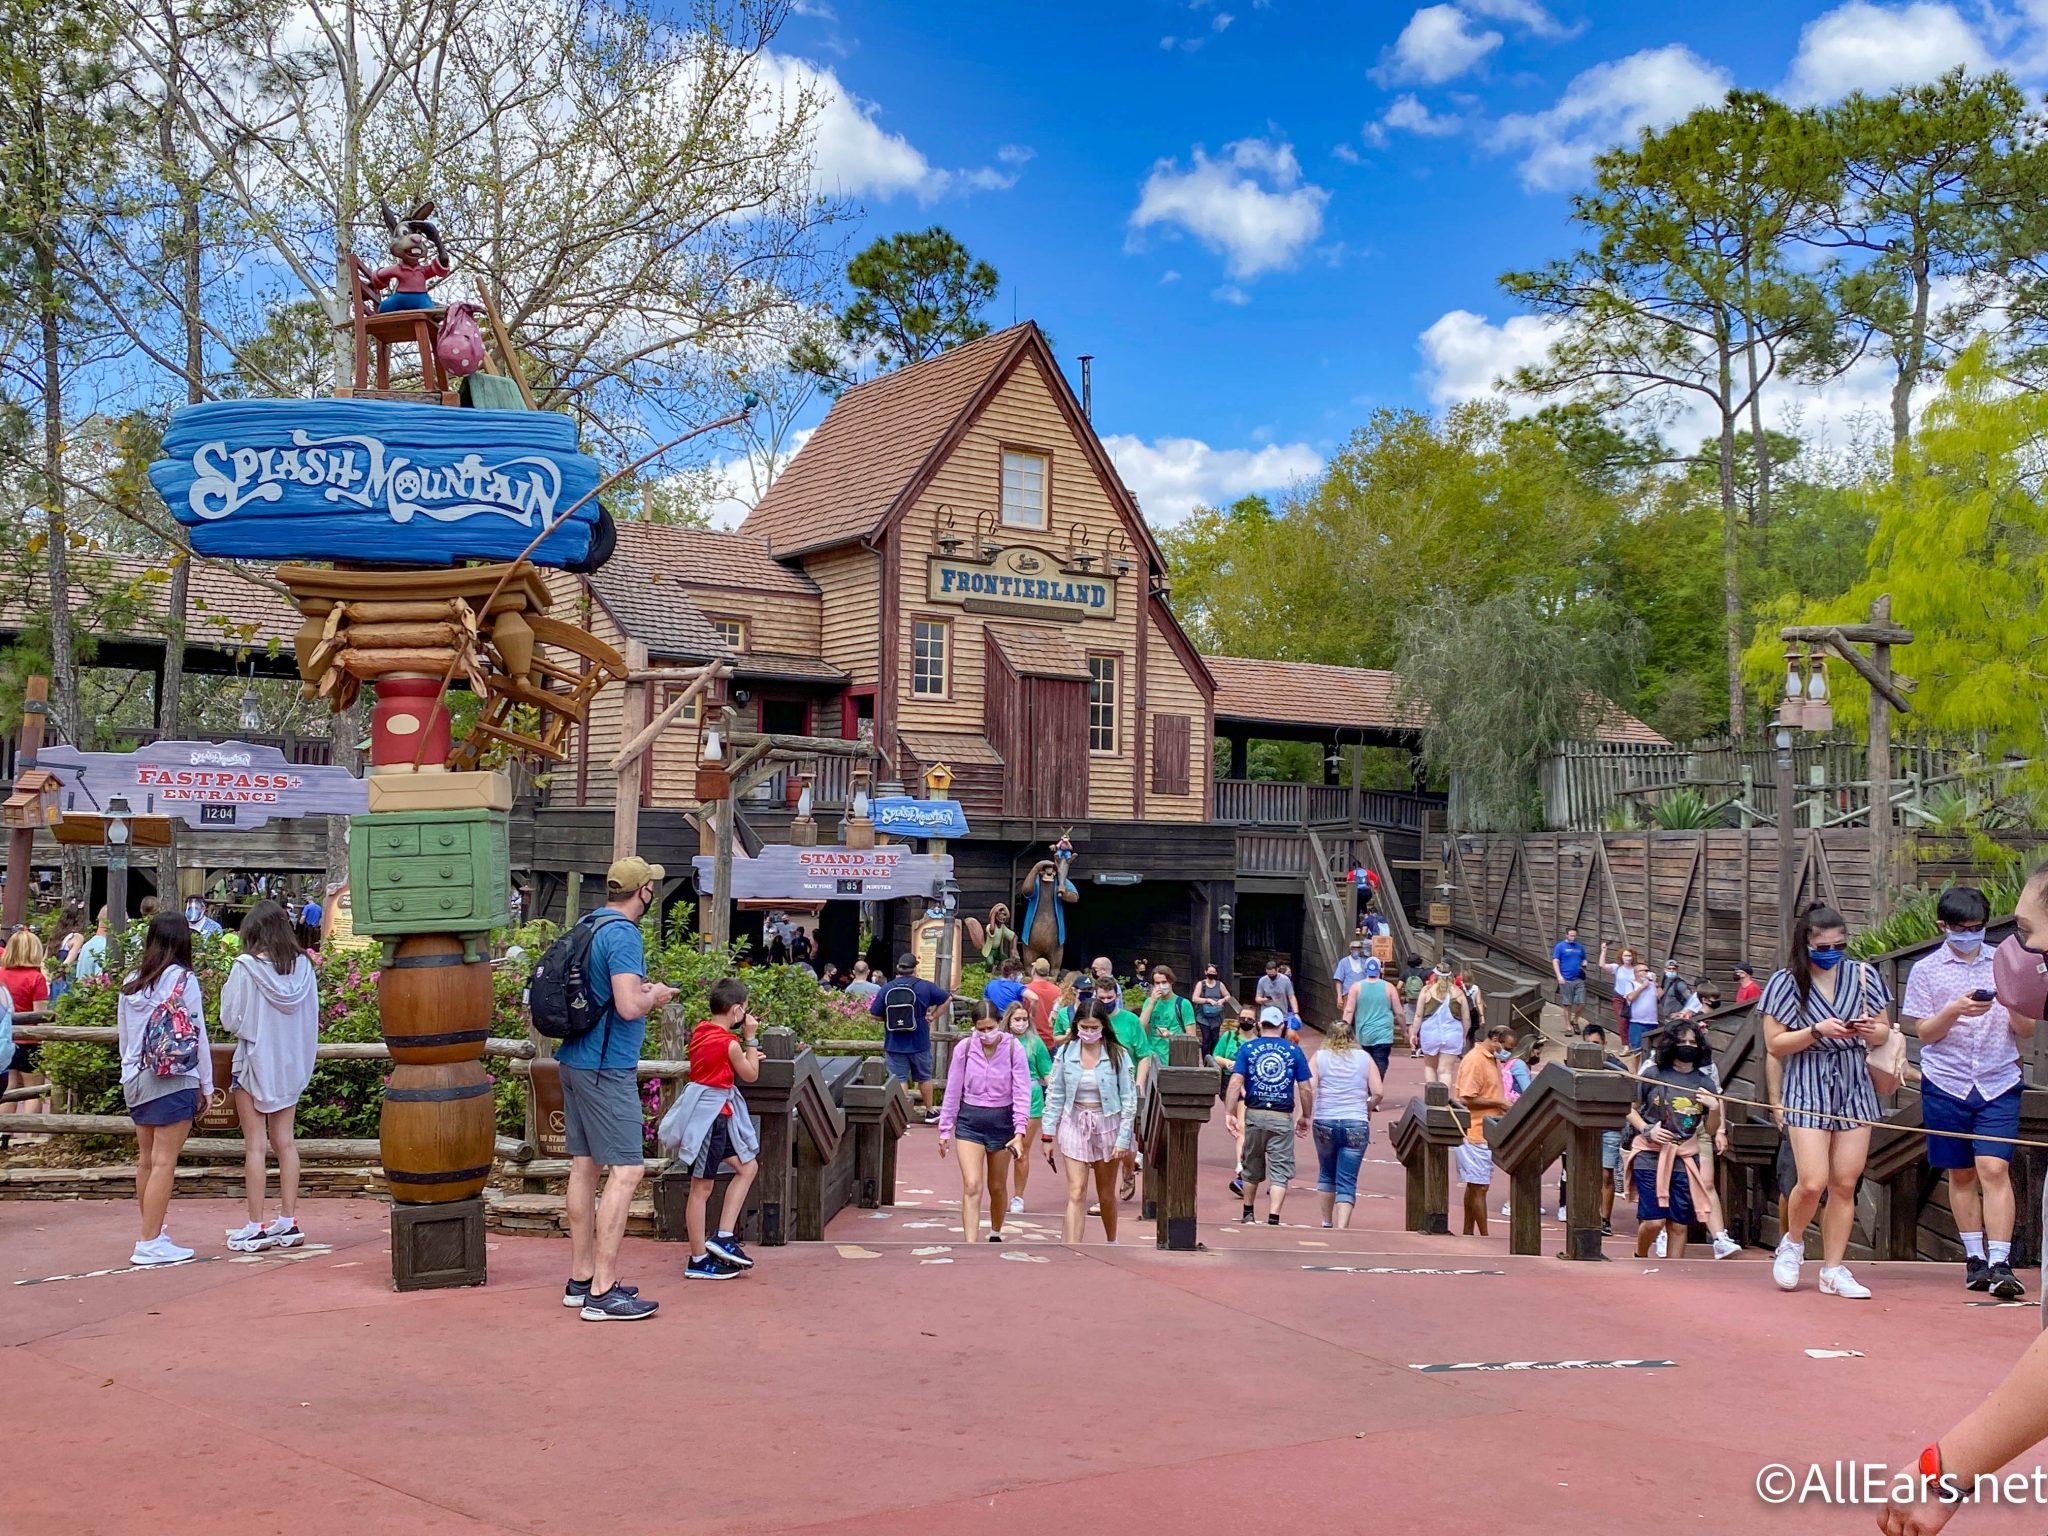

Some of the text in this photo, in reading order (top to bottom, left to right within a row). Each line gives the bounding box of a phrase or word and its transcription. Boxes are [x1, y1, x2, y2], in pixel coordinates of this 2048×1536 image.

[940, 568, 1106, 608] FRONTIERLAND
[163, 789, 277, 802] ENTRANCE
[205, 807, 233, 819] 12:04
[809, 867, 890, 877] ENTRANCE
[846, 881, 858, 890] 85
[1247, 1043, 1295, 1067] AMERICAN
[1251, 1075, 1291, 1092] FIGHTER
